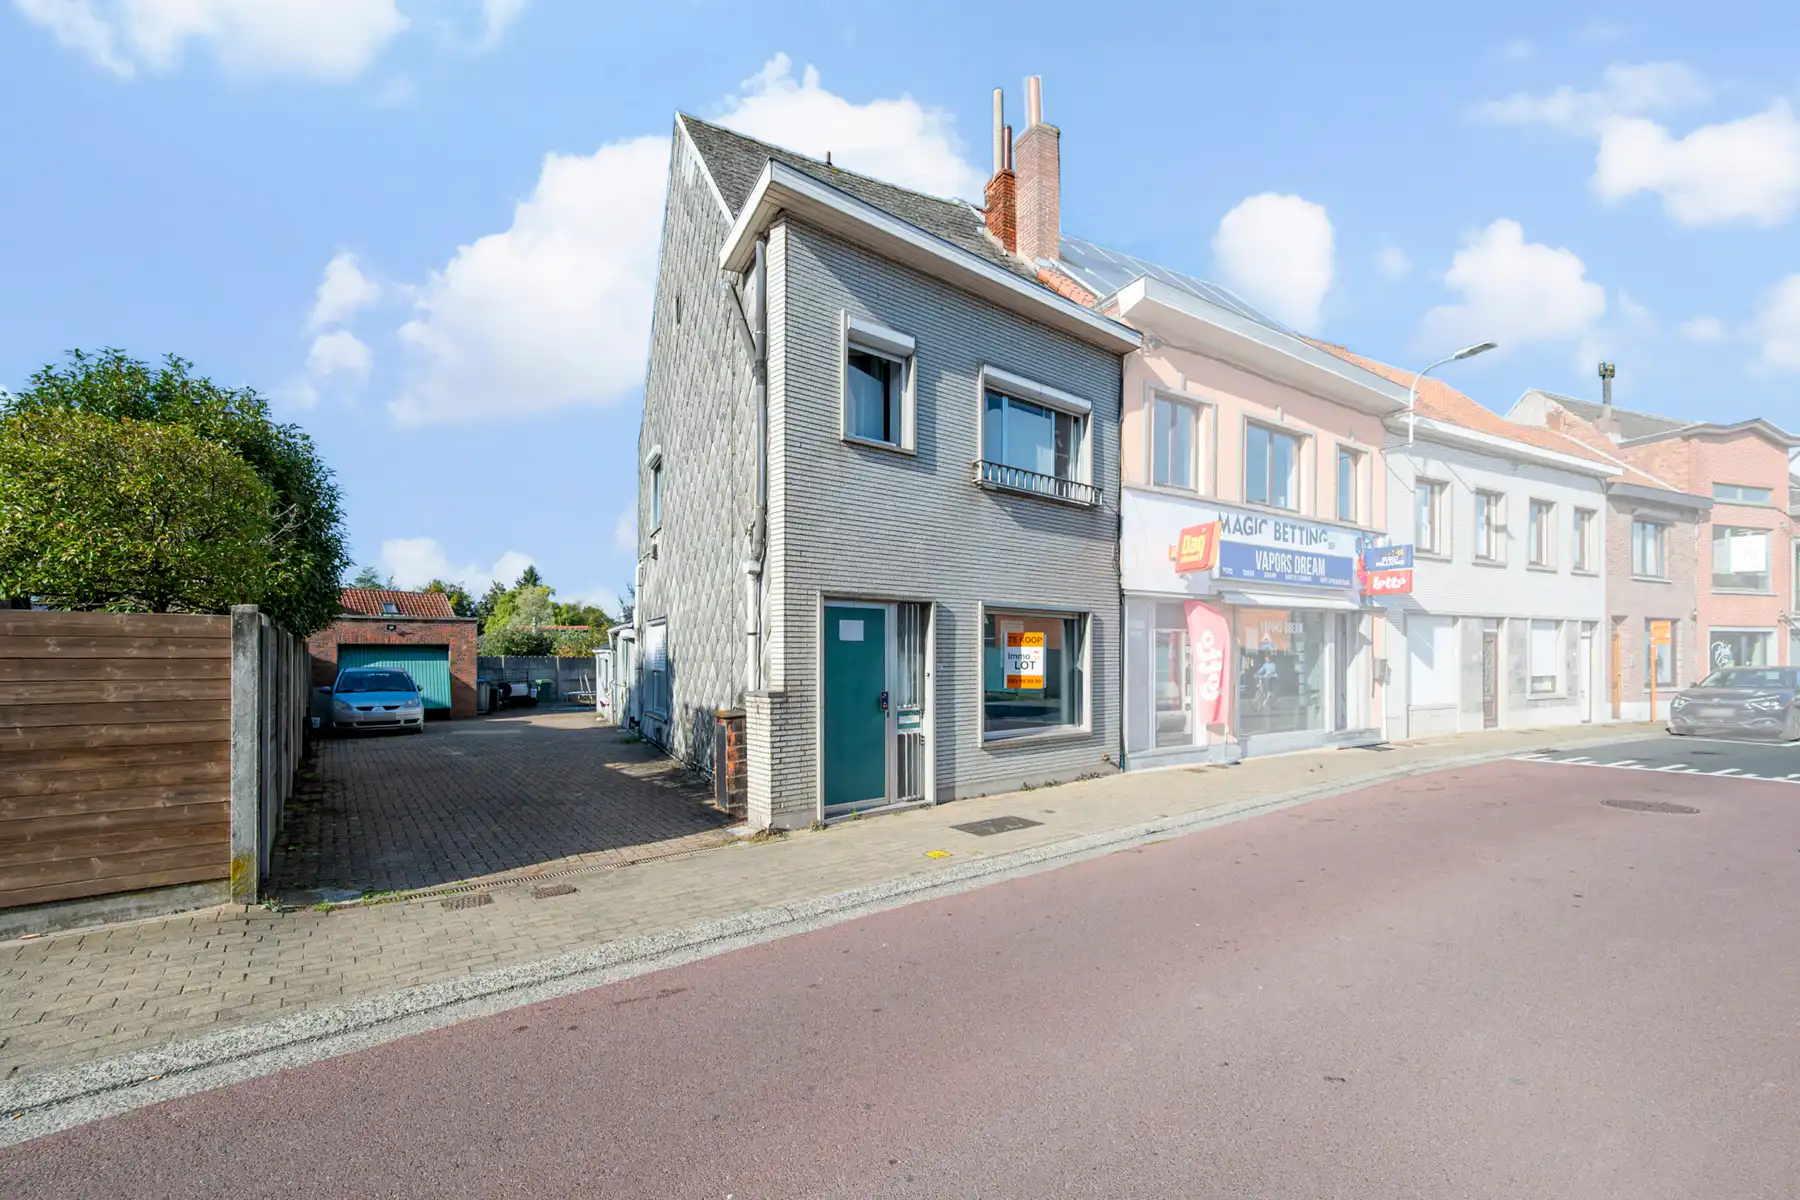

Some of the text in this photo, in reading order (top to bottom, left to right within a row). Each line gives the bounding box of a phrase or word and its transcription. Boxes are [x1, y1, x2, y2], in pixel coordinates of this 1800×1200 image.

[1255, 550, 1326, 577] VAPORS DREAM
[1008, 636, 1042, 644] TE KOOP
[1008, 652, 1030, 660] Immo
[1014, 660, 1036, 670] LOT
